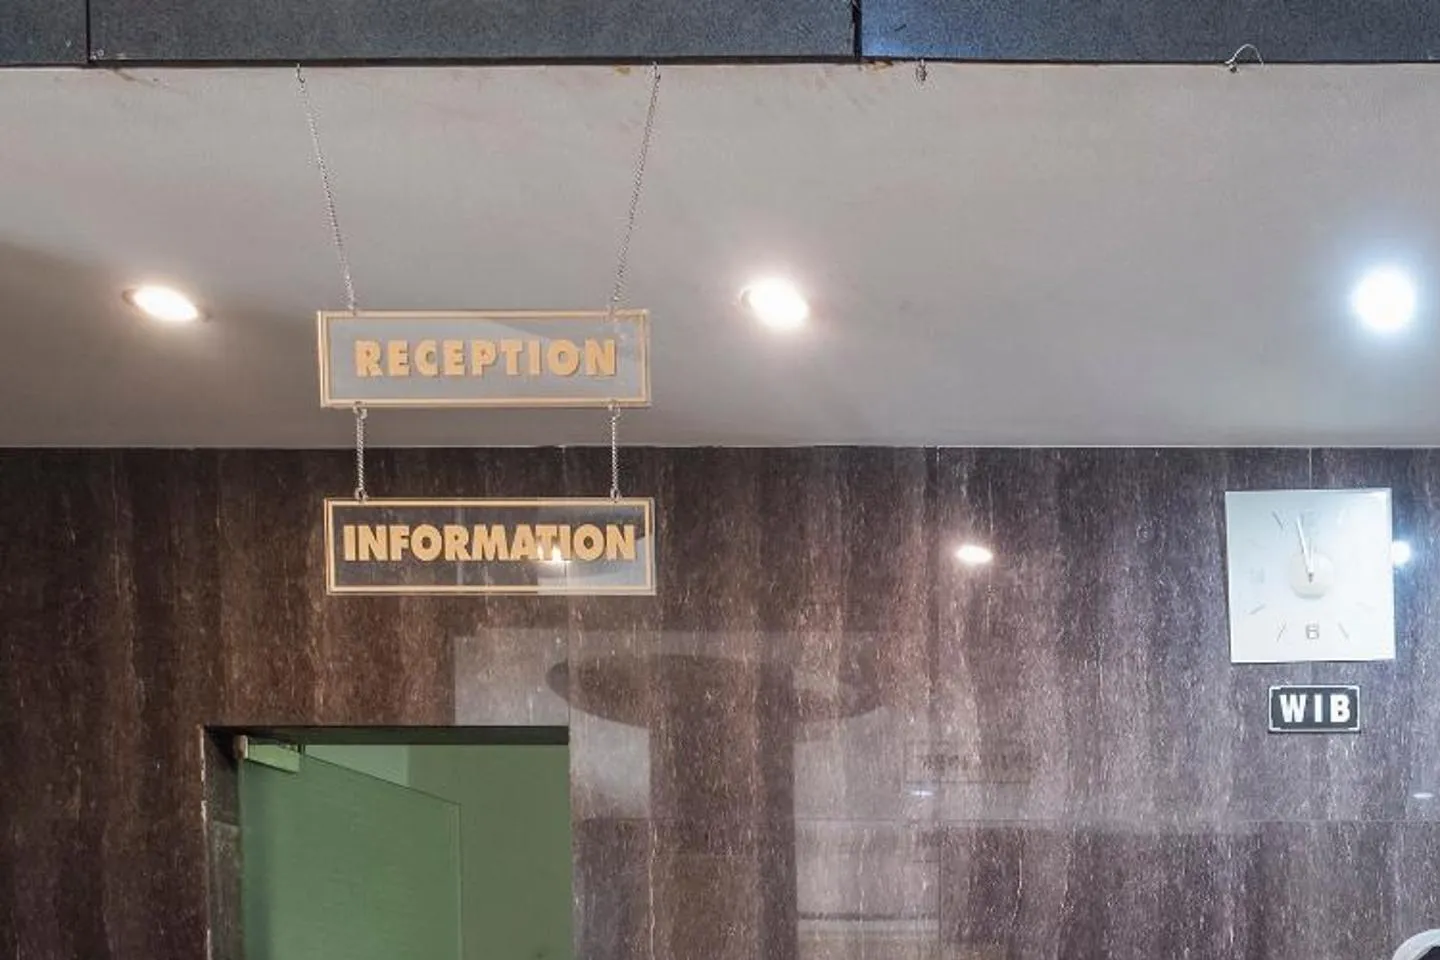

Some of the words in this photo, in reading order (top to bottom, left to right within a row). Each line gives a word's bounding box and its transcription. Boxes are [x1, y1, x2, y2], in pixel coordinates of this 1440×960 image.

[354, 339, 618, 378] RECEPTION
[342, 523, 637, 563] INFORMATION
[1305, 623, 1320, 640] 6
[1279, 693, 1351, 724] WIB
